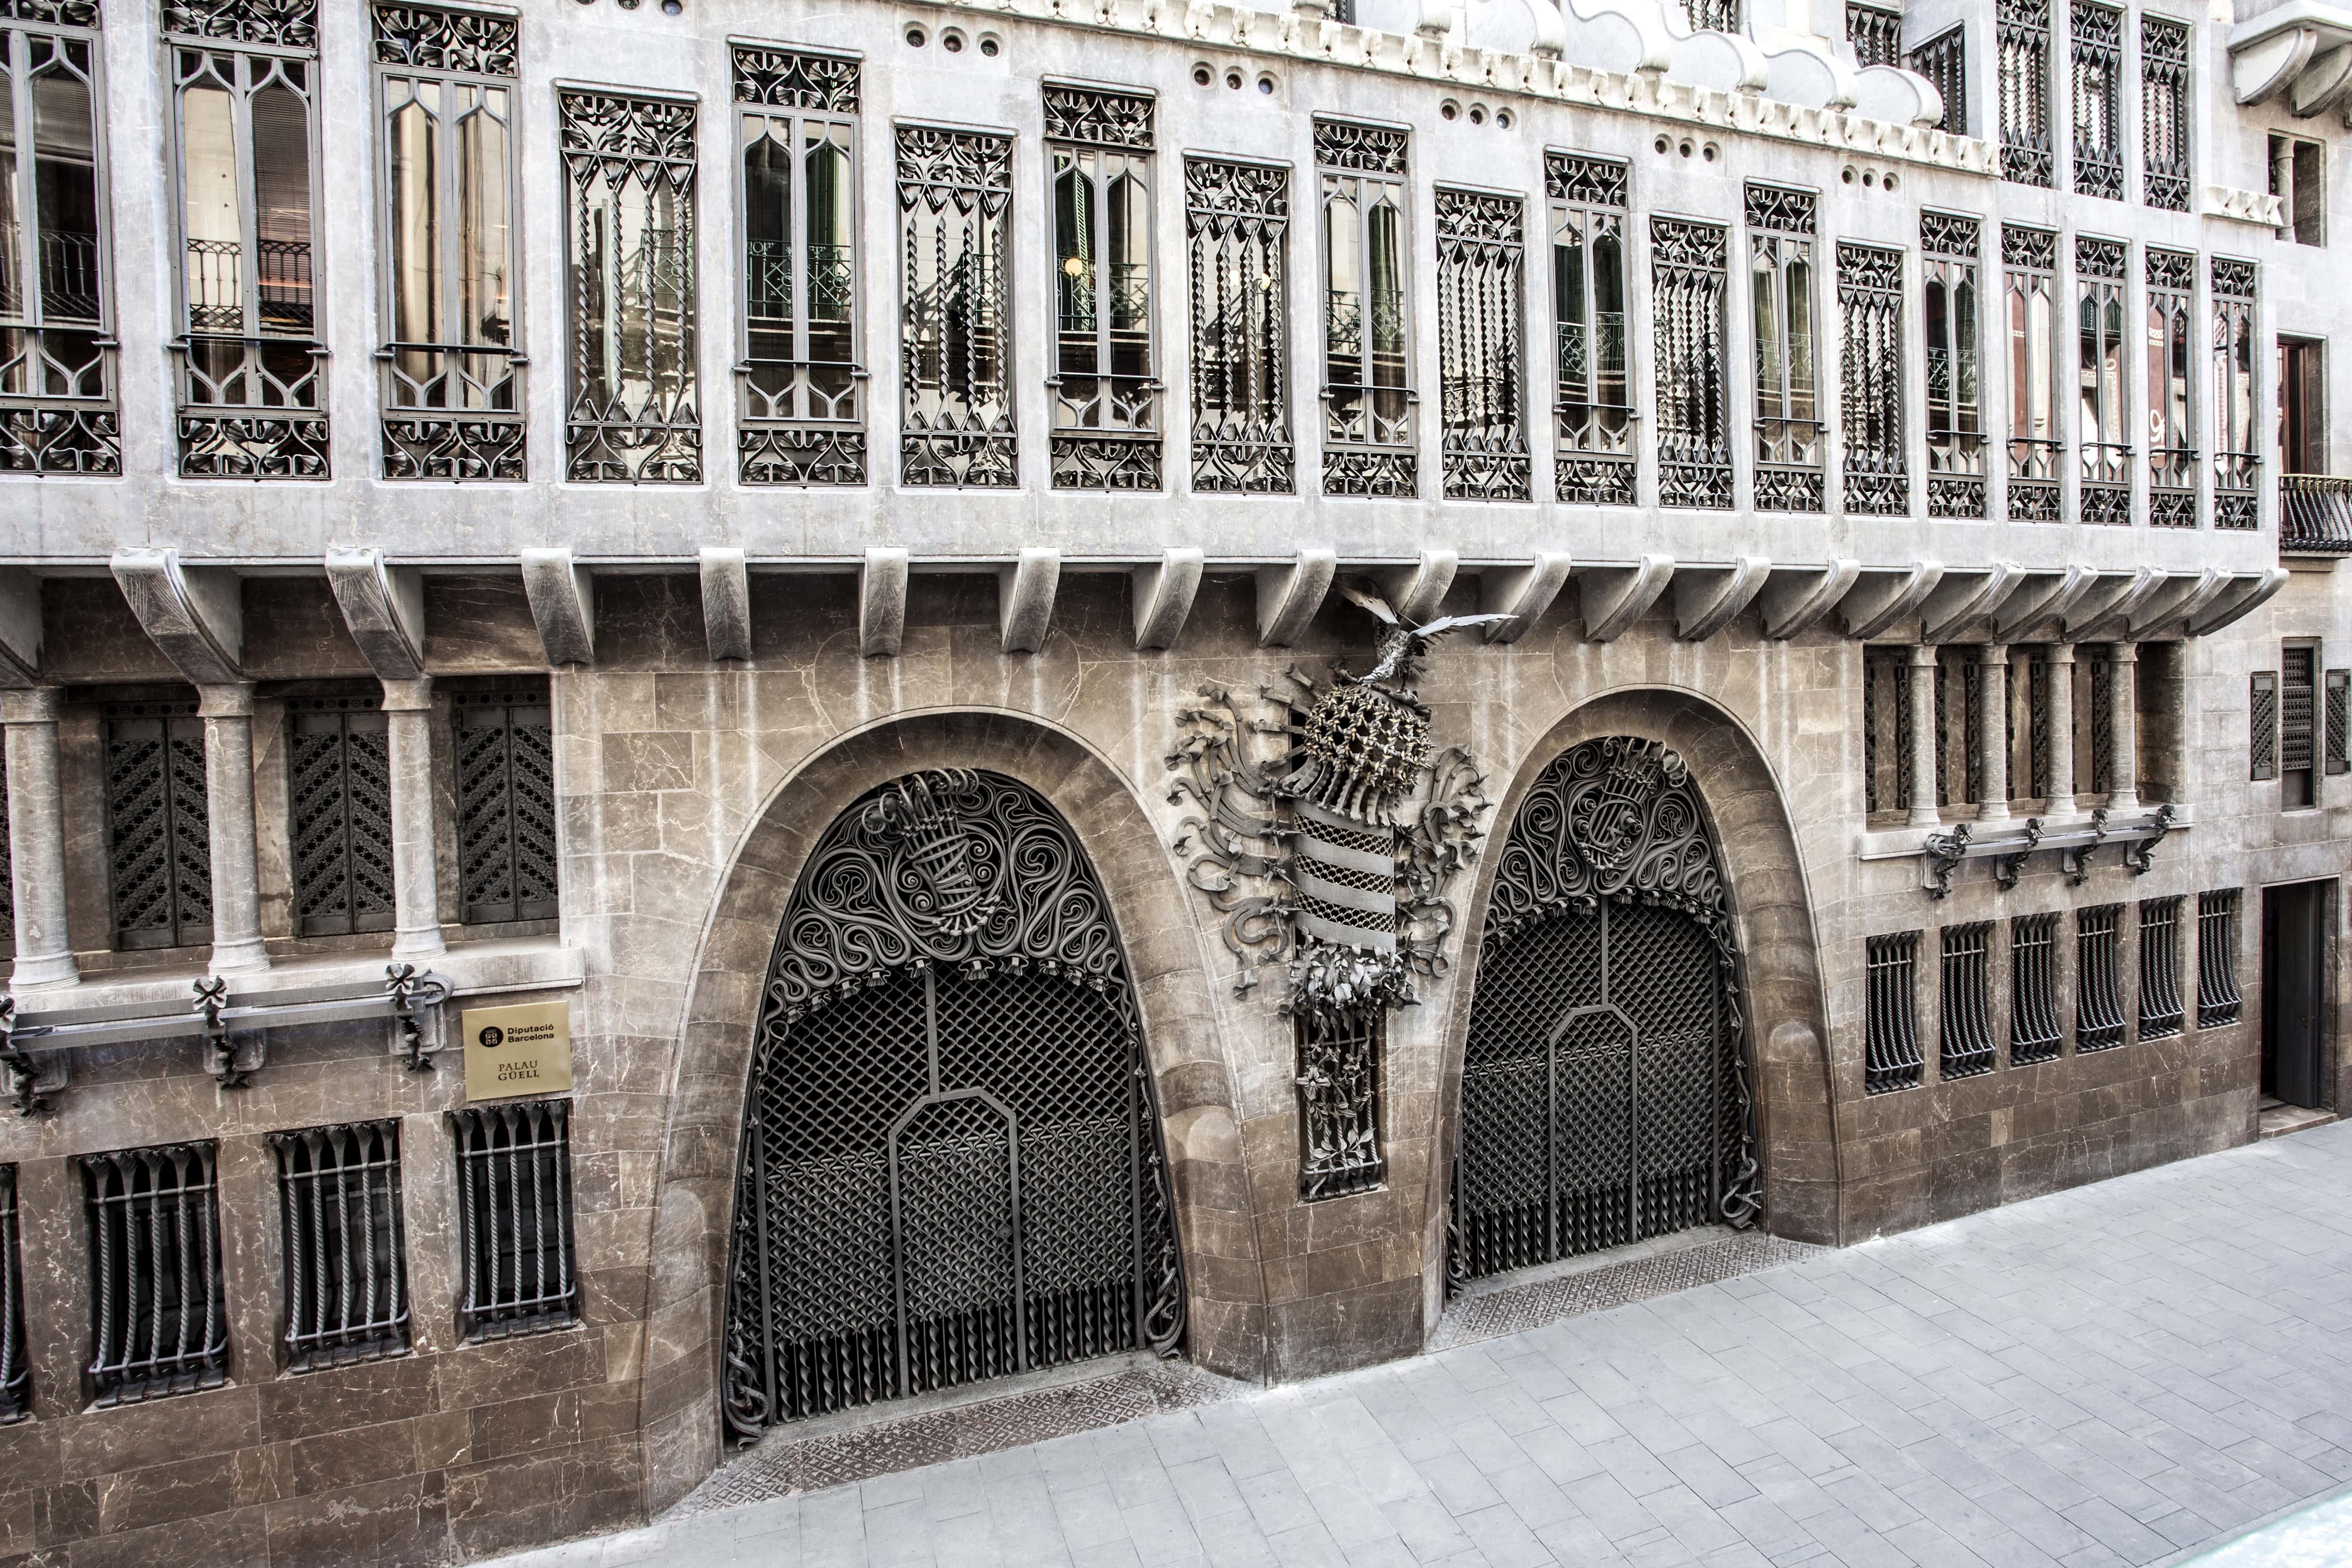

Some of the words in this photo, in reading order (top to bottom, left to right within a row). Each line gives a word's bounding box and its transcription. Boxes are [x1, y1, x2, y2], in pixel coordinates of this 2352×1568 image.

[507, 1023, 554, 1035] Diputació
[508, 1033, 554, 1042] Barcelona
[499, 1060, 538, 1071] PALAU
[498, 1070, 540, 1081] GÜELL
